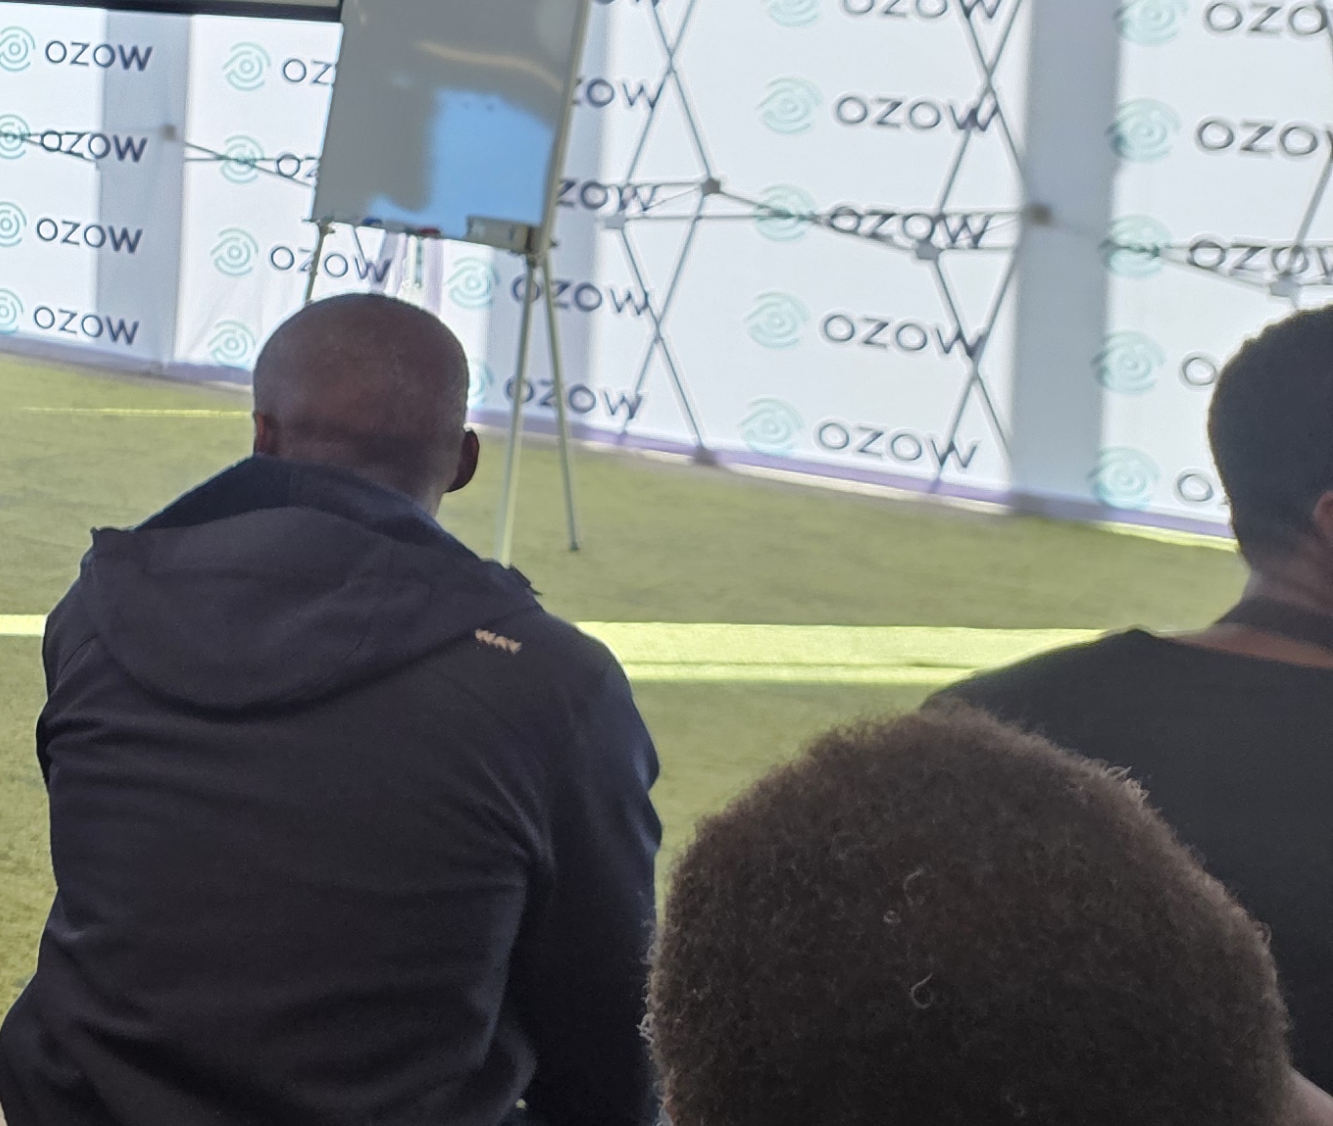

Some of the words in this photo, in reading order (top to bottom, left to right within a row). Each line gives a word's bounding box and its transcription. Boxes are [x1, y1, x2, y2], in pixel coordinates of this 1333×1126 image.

[1204, 2, 1331, 36] OZO
[44, 40, 153, 72] OZOW
[282, 58, 334, 86] OZ
[574, 77, 665, 111] OW
[835, 95, 999, 132] OZOW
[40, 130, 148, 163] OZOW
[1195, 119, 1332, 157] OZO
[276, 152, 318, 179] OZ
[556, 178, 659, 212] ZOW
[36, 217, 143, 255] OZOW
[830, 206, 995, 250] OZOW
[1187, 239, 1333, 276] OZO
[512, 275, 650, 317] OZOW
[33, 304, 140, 346] OZOW
[823, 314, 985, 358] OZOW
[505, 378, 644, 420] OZOW
[818, 422, 978, 469] OZOW
